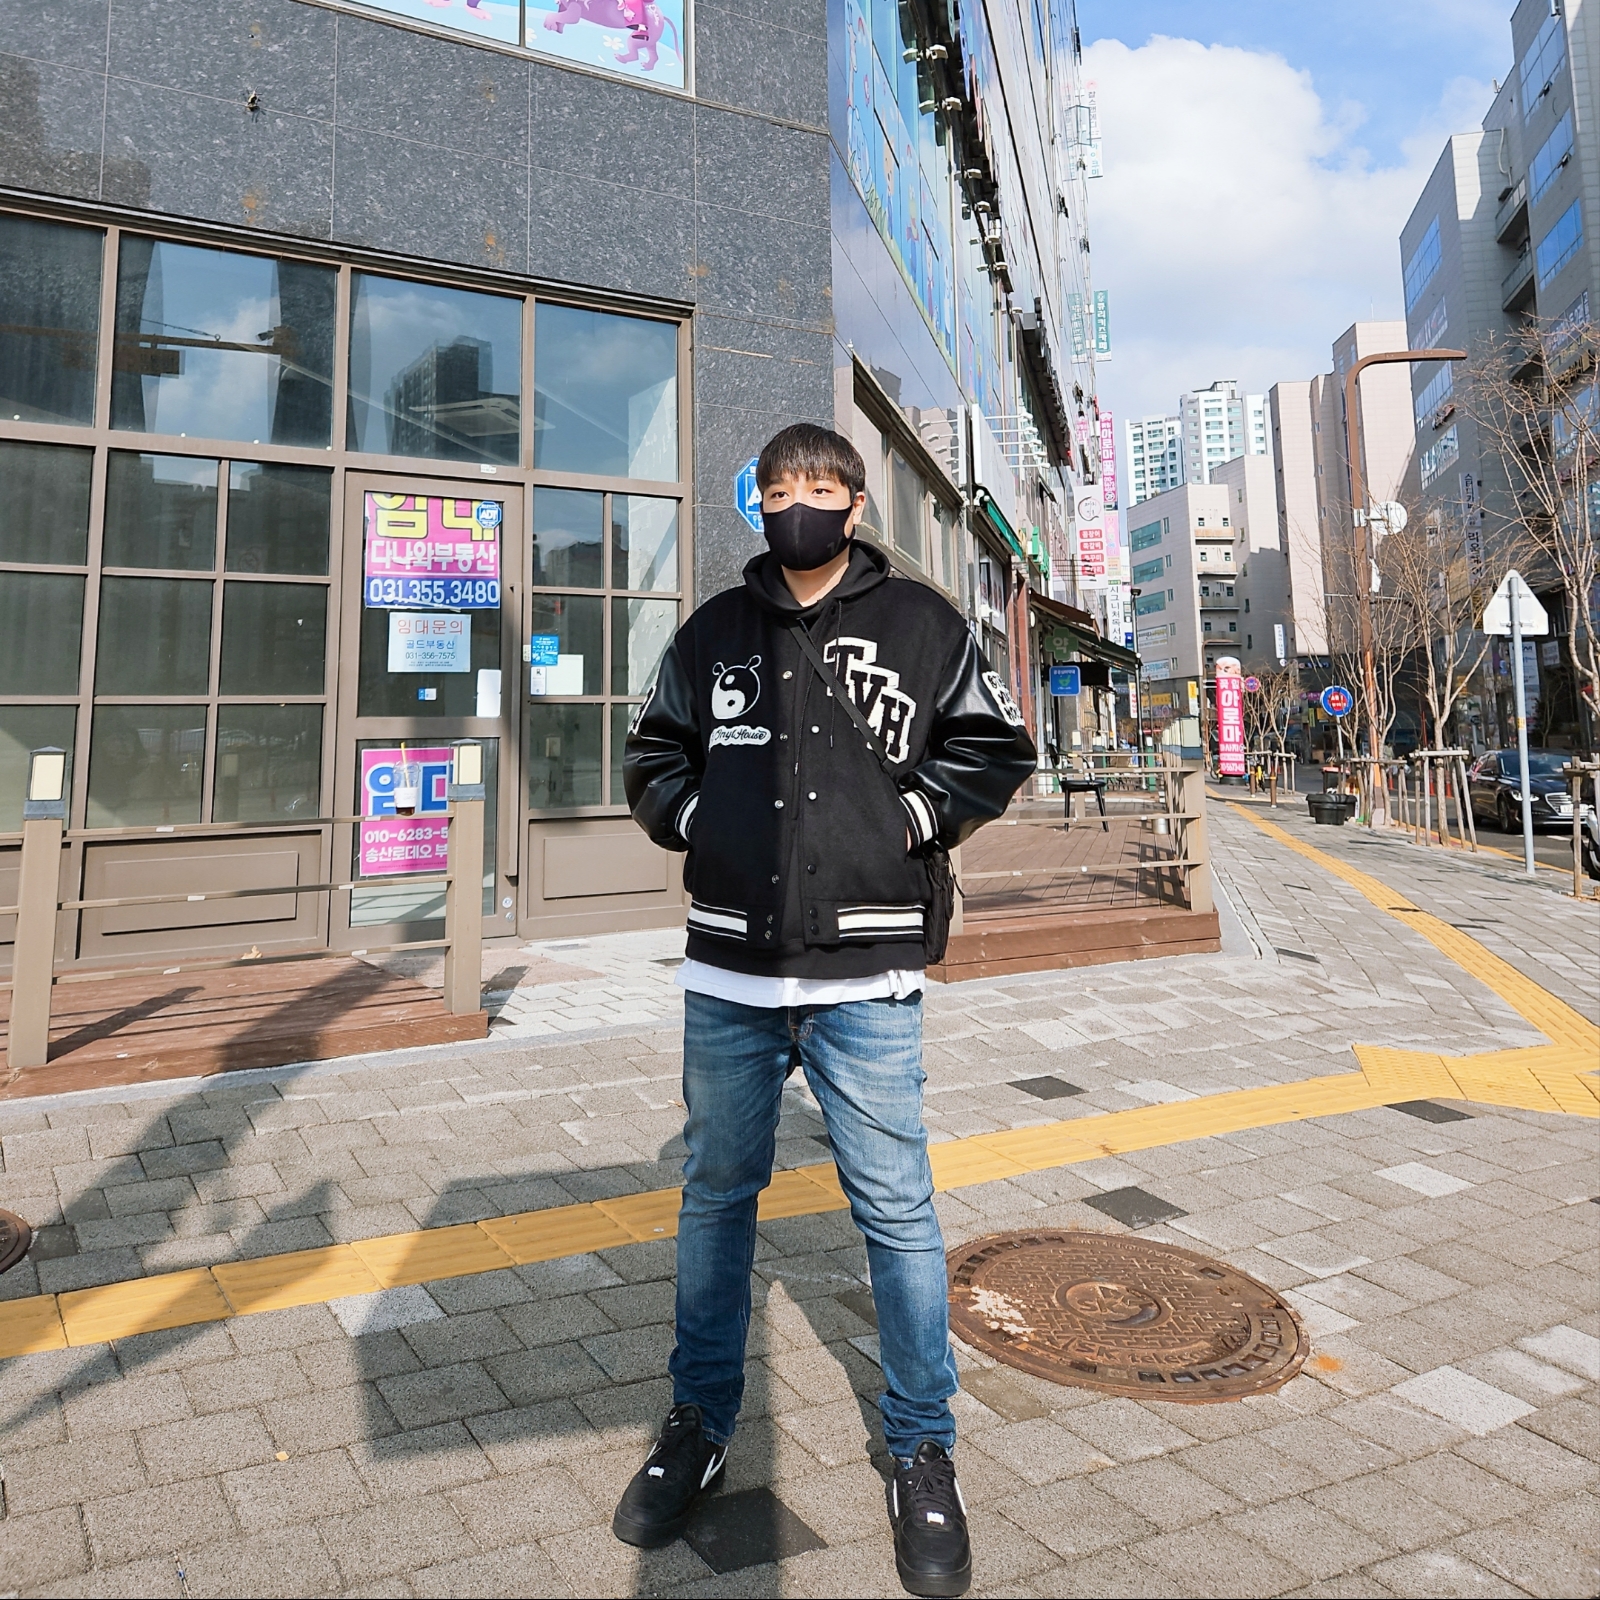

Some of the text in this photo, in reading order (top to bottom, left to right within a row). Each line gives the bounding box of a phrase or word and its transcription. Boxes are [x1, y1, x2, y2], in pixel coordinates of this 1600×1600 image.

[371, 540, 497, 572] 다나와부동산
[397, 619, 463, 635] 임대문의
[406, 640, 456, 650] 골드부동산
[1053, 637, 1069, 654] 약
[405, 651, 456, 660] 031-356-7575
[1221, 689, 1241, 742] 아로마
[365, 844, 433, 863] 송산로데오
